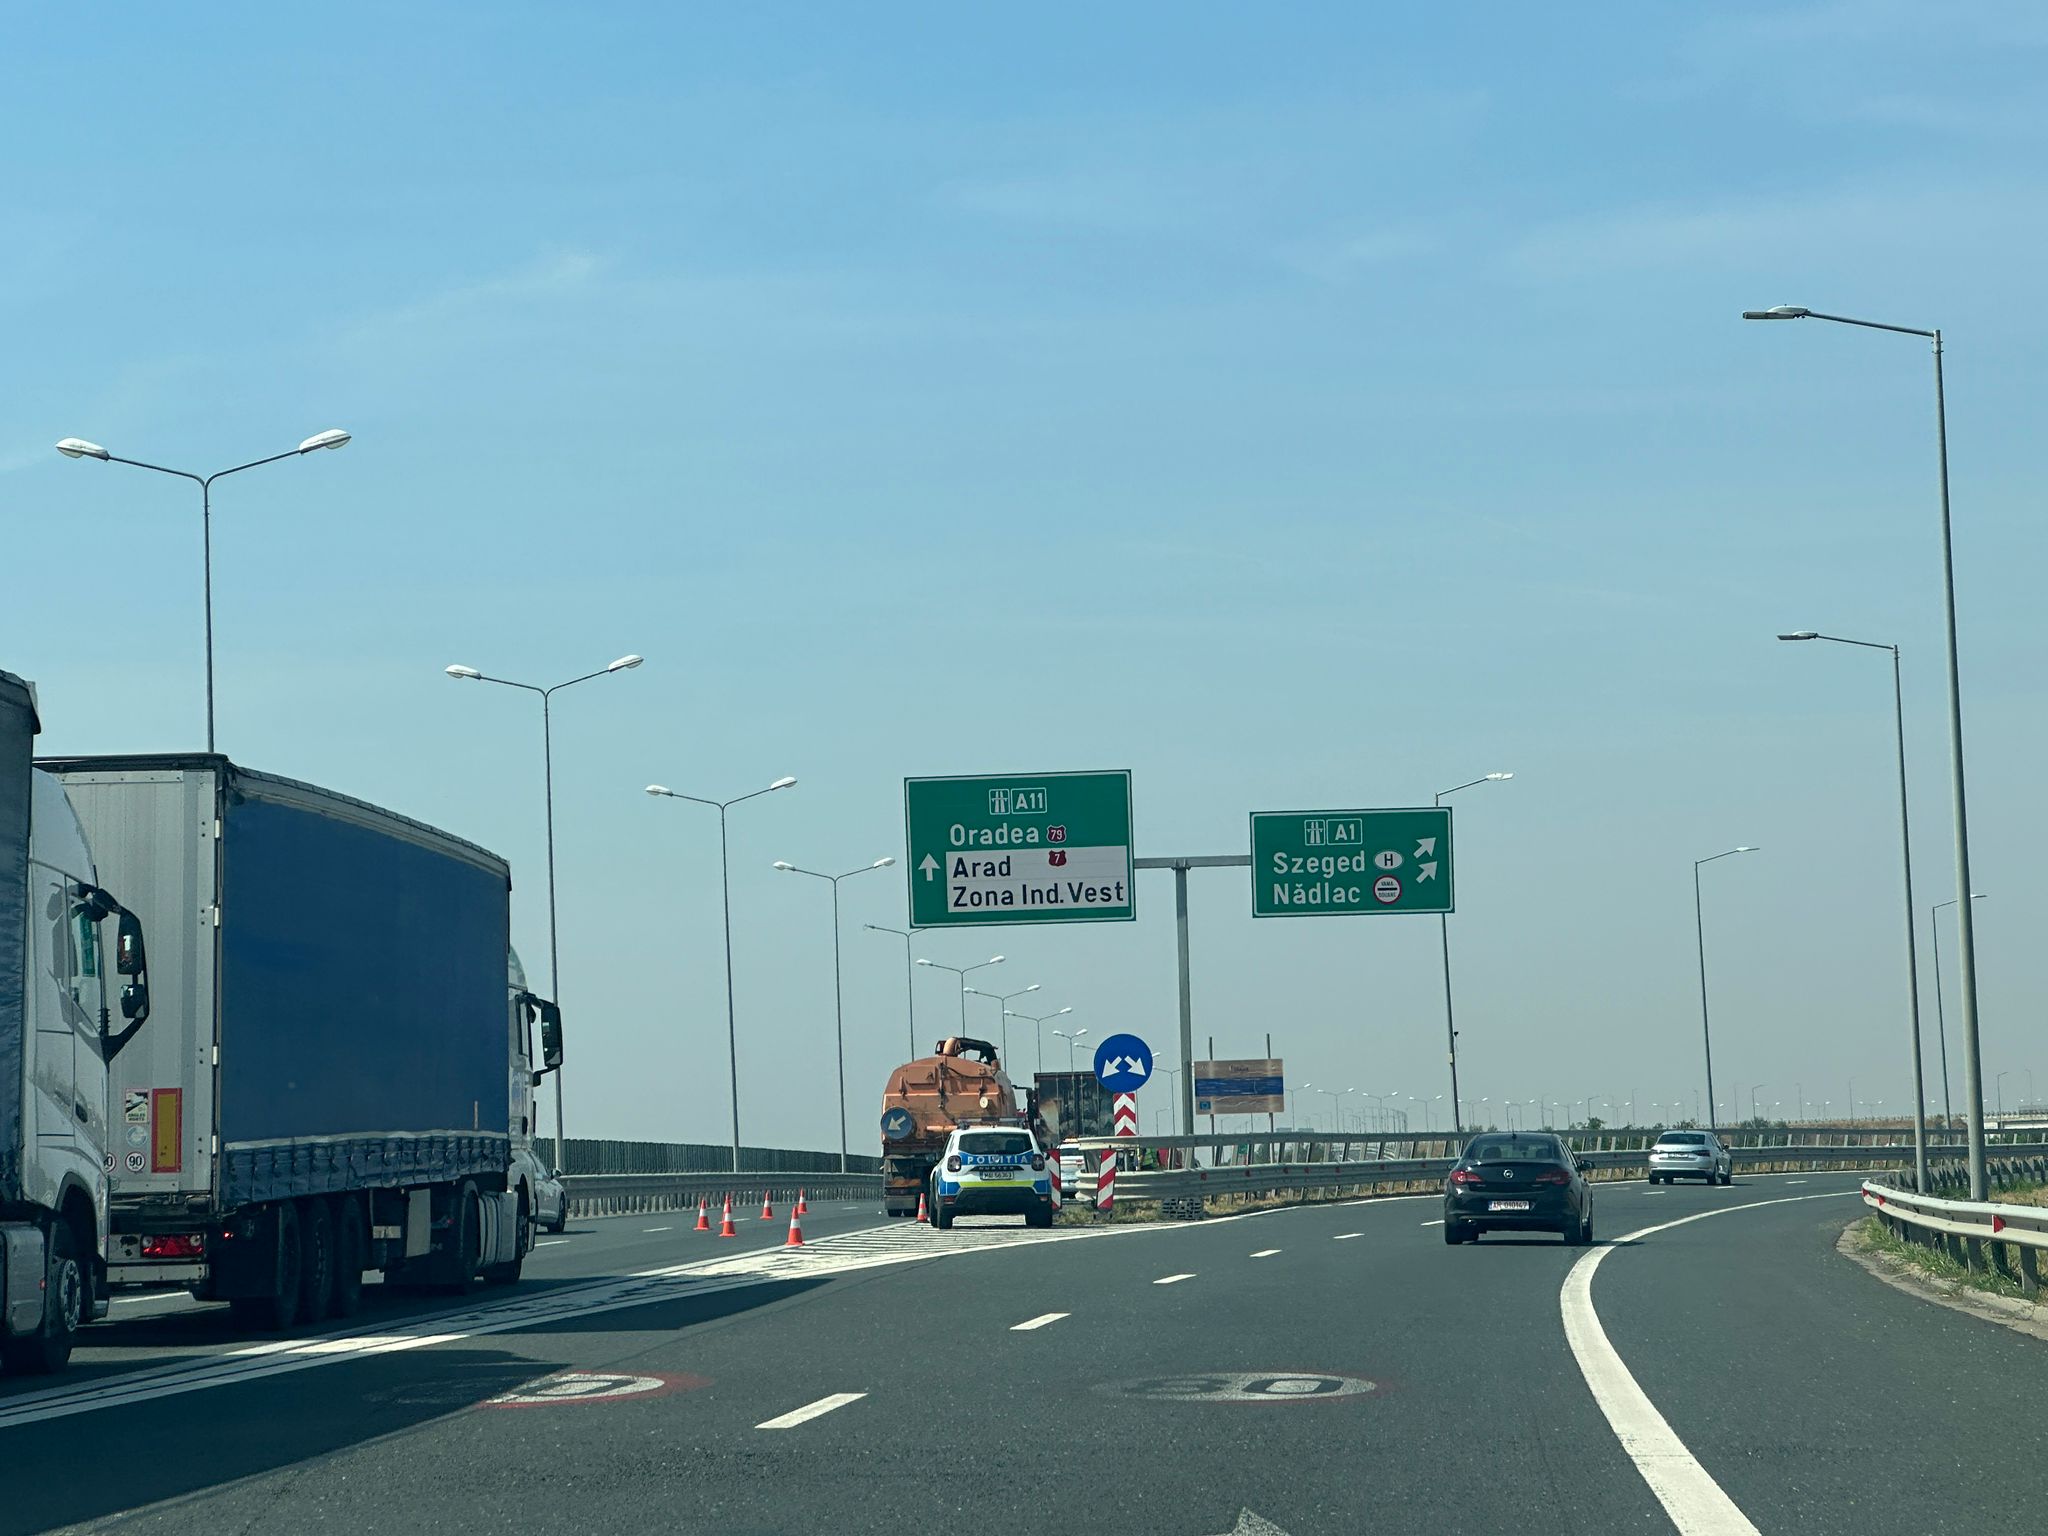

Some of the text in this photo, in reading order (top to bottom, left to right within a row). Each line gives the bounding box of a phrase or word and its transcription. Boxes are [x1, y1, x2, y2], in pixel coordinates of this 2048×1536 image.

[1015, 792, 1044, 810] A11
[949, 822, 1063, 846] Oradea 79
[1334, 823, 1356, 841] A1
[952, 853, 1061, 879] Arad 7
[1272, 850, 1394, 878] Szeged H
[952, 880, 1125, 908] Zona Ind. Vest
[1273, 881, 1361, 905] Nădlac
[103, 1156, 113, 1166] 0
[129, 1156, 143, 1166] 90
